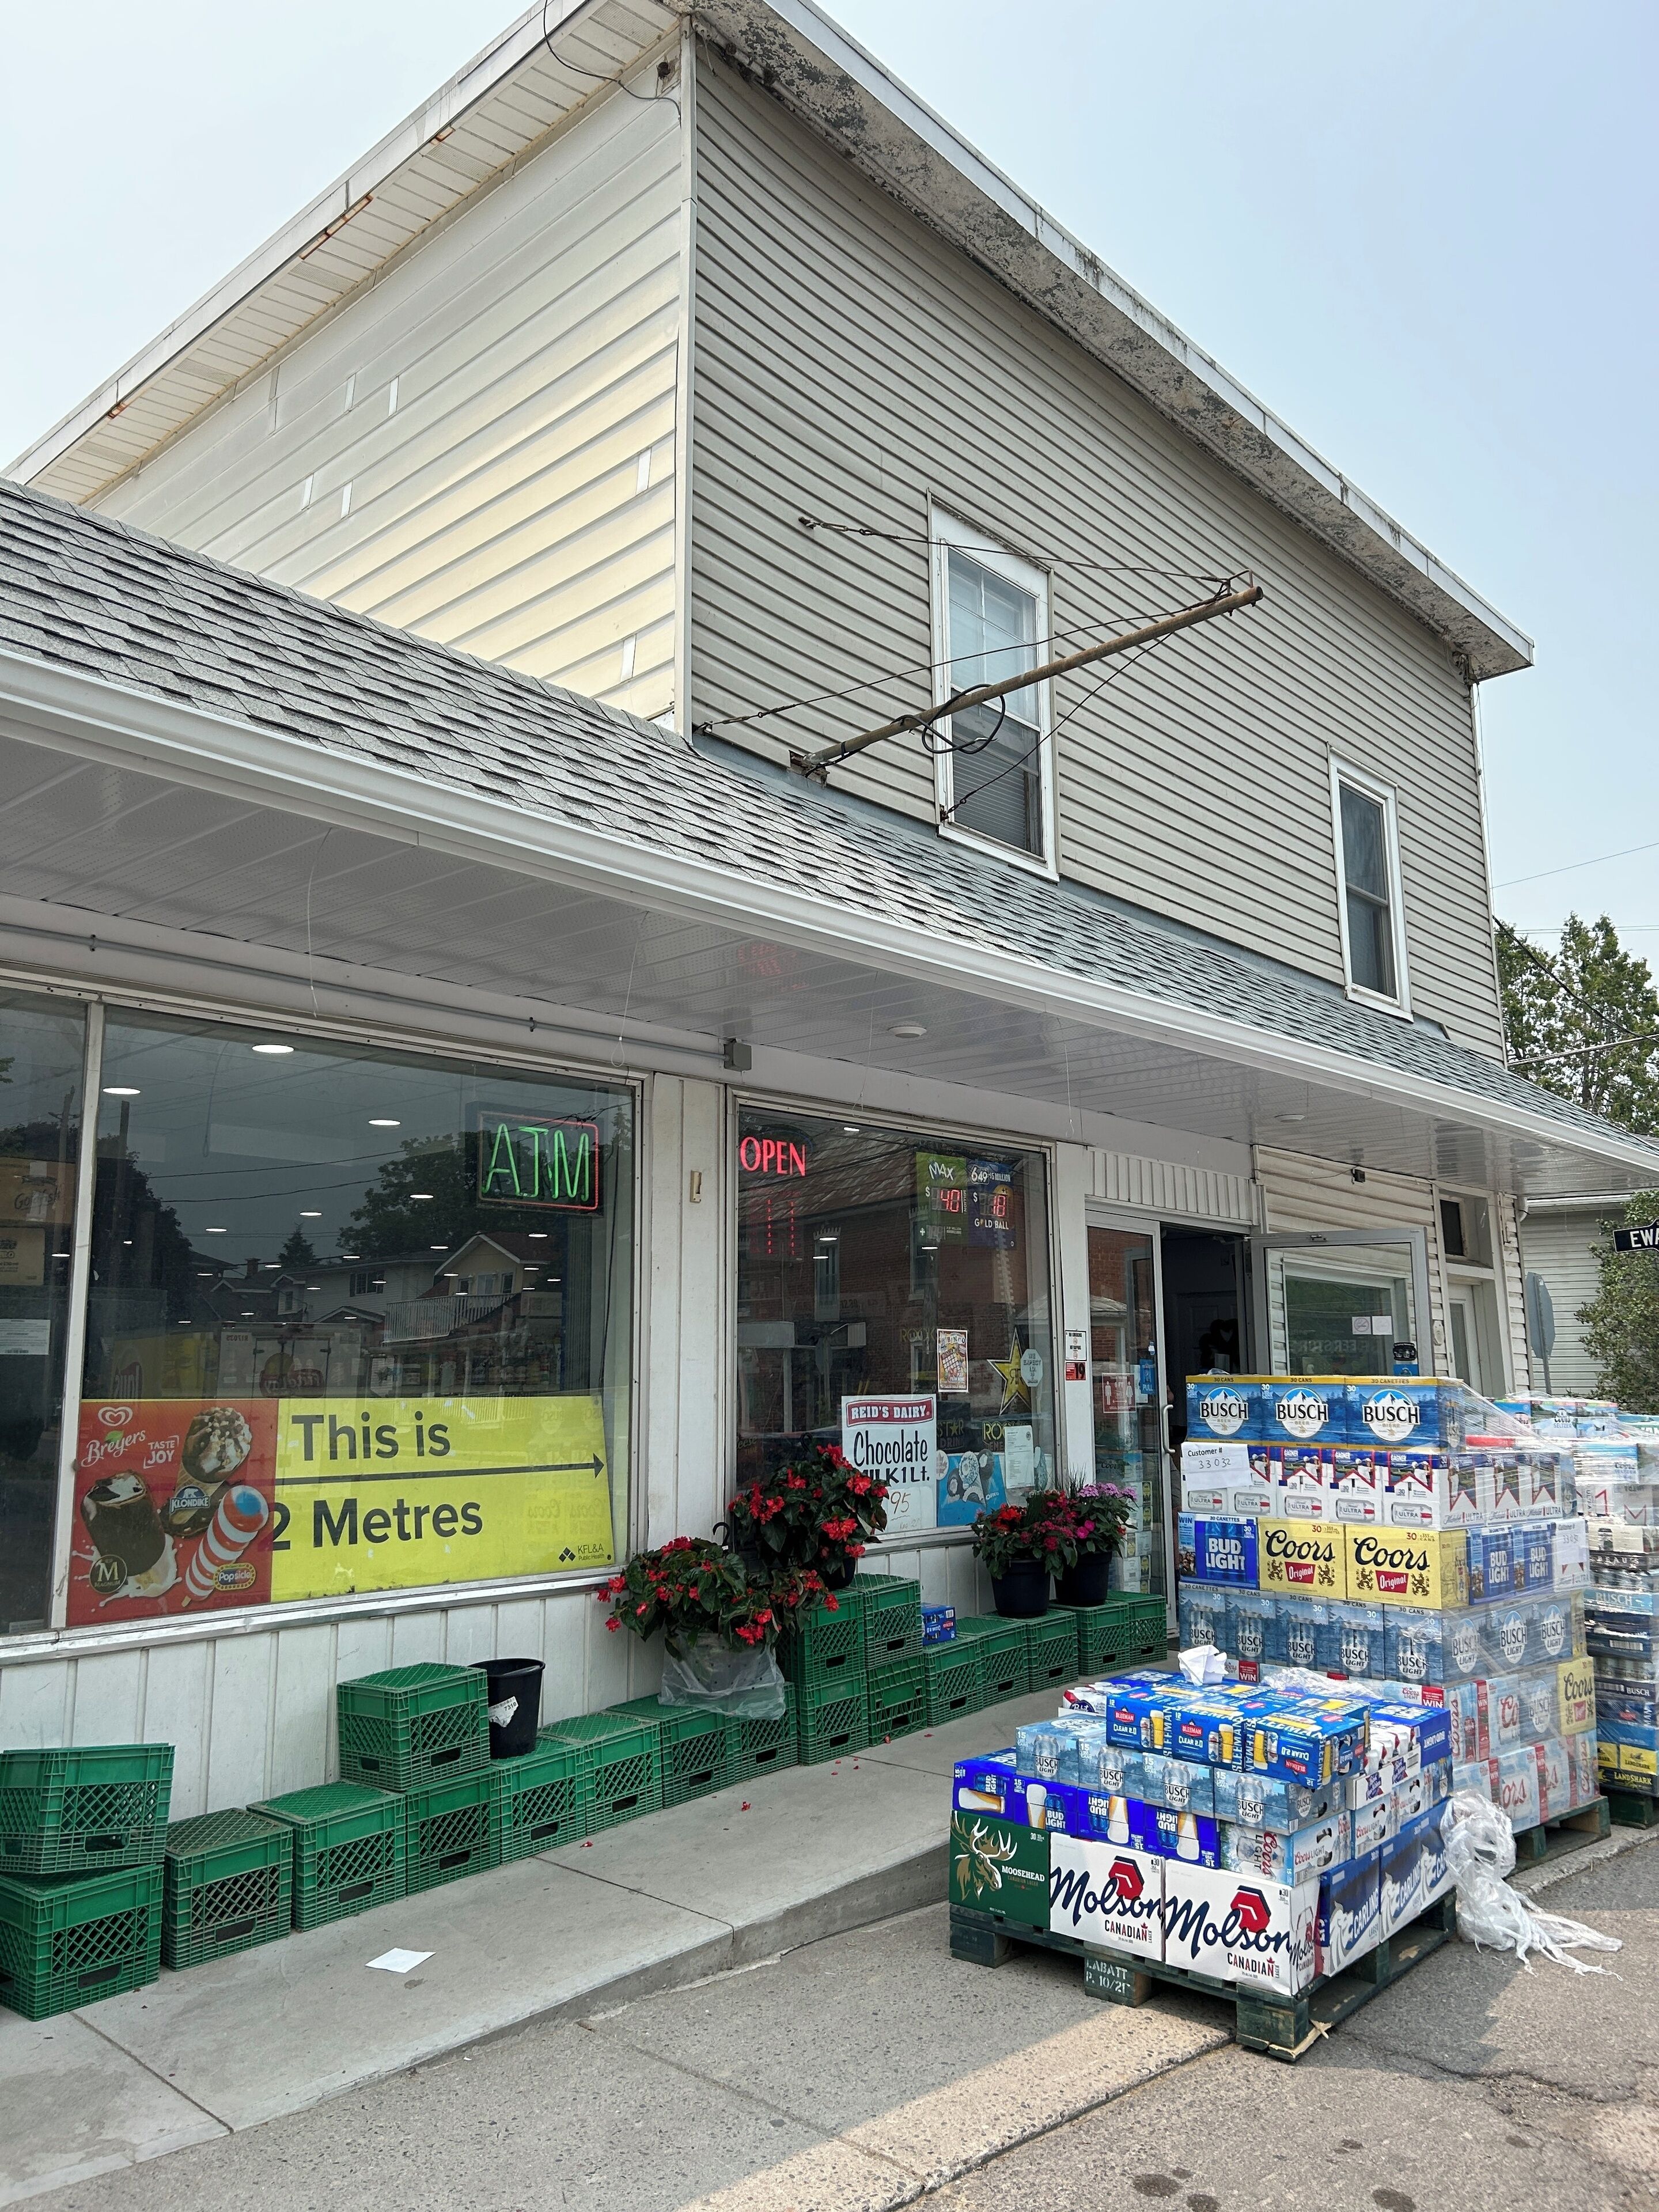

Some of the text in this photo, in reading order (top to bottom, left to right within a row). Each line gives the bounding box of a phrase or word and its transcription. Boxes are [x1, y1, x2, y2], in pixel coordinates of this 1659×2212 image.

[482, 1123, 590, 1202] ATM
[740, 1136, 805, 1176] OPEN
[929, 1161, 953, 1180] MAX
[941, 1190, 960, 1212] 40
[993, 1195, 1005, 1217] 18
[995, 1221, 1009, 1230] BALL
[1075, 1363, 1085, 1379] 19
[851, 1406, 889, 1419] REID'S
[1200, 1402, 1248, 1419] BUSCH
[1277, 1404, 1327, 1421] BUSCH
[1363, 1406, 1419, 1423] BUSCH
[291, 1411, 450, 1461] This is
[81, 1430, 146, 1467] Breyers
[148, 1440, 175, 1450] TASTE
[854, 1429, 928, 1467] Chocolate
[149, 1450, 175, 1464] JOY
[1188, 1448, 1217, 1457] Customer
[170, 1496, 210, 1510] KLONDIKE
[269, 1499, 483, 1550] 2 Metres
[1312, 1525, 1321, 1533] 30
[1406, 1532, 1416, 1540] 30
[577, 1543, 604, 1554] KFL&A
[1209, 1537, 1241, 1554] BUD
[1265, 1529, 1335, 1562] Coors
[1354, 1536, 1430, 1571] Coors
[1491, 1550, 1507, 1566] BUD
[1531, 1547, 1547, 1562] BUD
[1206, 1552, 1245, 1570] LIGHT
[218, 1569, 252, 1583] Popsicle
[1289, 1566, 1313, 1580] Original
[1489, 1566, 1509, 1584] LIGHT
[1529, 1562, 1548, 1578] LIGHT
[1380, 1574, 1407, 1589] Original
[1595, 1592, 1633, 1606] BUSCH
[1190, 1628, 1215, 1641] BUSCH
[1541, 1618, 1566, 1640] BUSCH
[1237, 1635, 1263, 1647] BUSCH
[1500, 1626, 1527, 1648] BUSCH
[1288, 1642, 1315, 1654] BUSCH
[1340, 1647, 1369, 1662] BUSCH
[1507, 1646, 1522, 1656] LIGHT
[1346, 1659, 1365, 1667] LIGHT
[1397, 1655, 1427, 1669] BUSCH
[1240, 1673, 1256, 1681] WIN
[1402, 1667, 1423, 1675] LIGHT
[1563, 1672, 1593, 1702] Coors
[1627, 1687, 1650, 1696] BUSCH
[1423, 1699, 1443, 1707] WIN
[1115, 1711, 1134, 1721] SLEEMAN
[1113, 1724, 1137, 1735] CLEAR 2.0
[1181, 1725, 1202, 1736] SLEEMAN
[1179, 1736, 1203, 1748] CLEAR 2.0
[1035, 1757, 1058, 1770] BUSCH
[1100, 1770, 1124, 1783] BUSCH
[1614, 1771, 1652, 1785] LANDSHARK
[1164, 1785, 1190, 1798] BUSCH
[1088, 1796, 1109, 1808] LIGHT
[1237, 1800, 1264, 1815] BUSCH
[1047, 1810, 1064, 1820] BUD
[1090, 1805, 1107, 1816] BUD
[1242, 1812, 1260, 1820] LIGHT
[1046, 1817, 1066, 1828] LIGHT
[1156, 1812, 1178, 1824] LIGHT
[1158, 1821, 1176, 1832] BUD
[1254, 1834, 1263, 1870] LIGHT
[1261, 1831, 1278, 1875] Coors
[1311, 1845, 1325, 1857] LIGHT
[1153, 1858, 1160, 1866] 30
[1002, 1866, 1045, 1882] MOOSEHEAD
[1400, 1861, 1421, 1907] CARLING
[1051, 1866, 1165, 1926] Molson
[1282, 1889, 1289, 1897] 30
[1354, 1888, 1379, 1938] CARLING
[1105, 1920, 1147, 1942] CANADIAN
[1165, 1896, 1291, 1959] Molson
[1086, 1959, 1127, 1980] LABATT
[1227, 1952, 1274, 1978] CANADIAN
